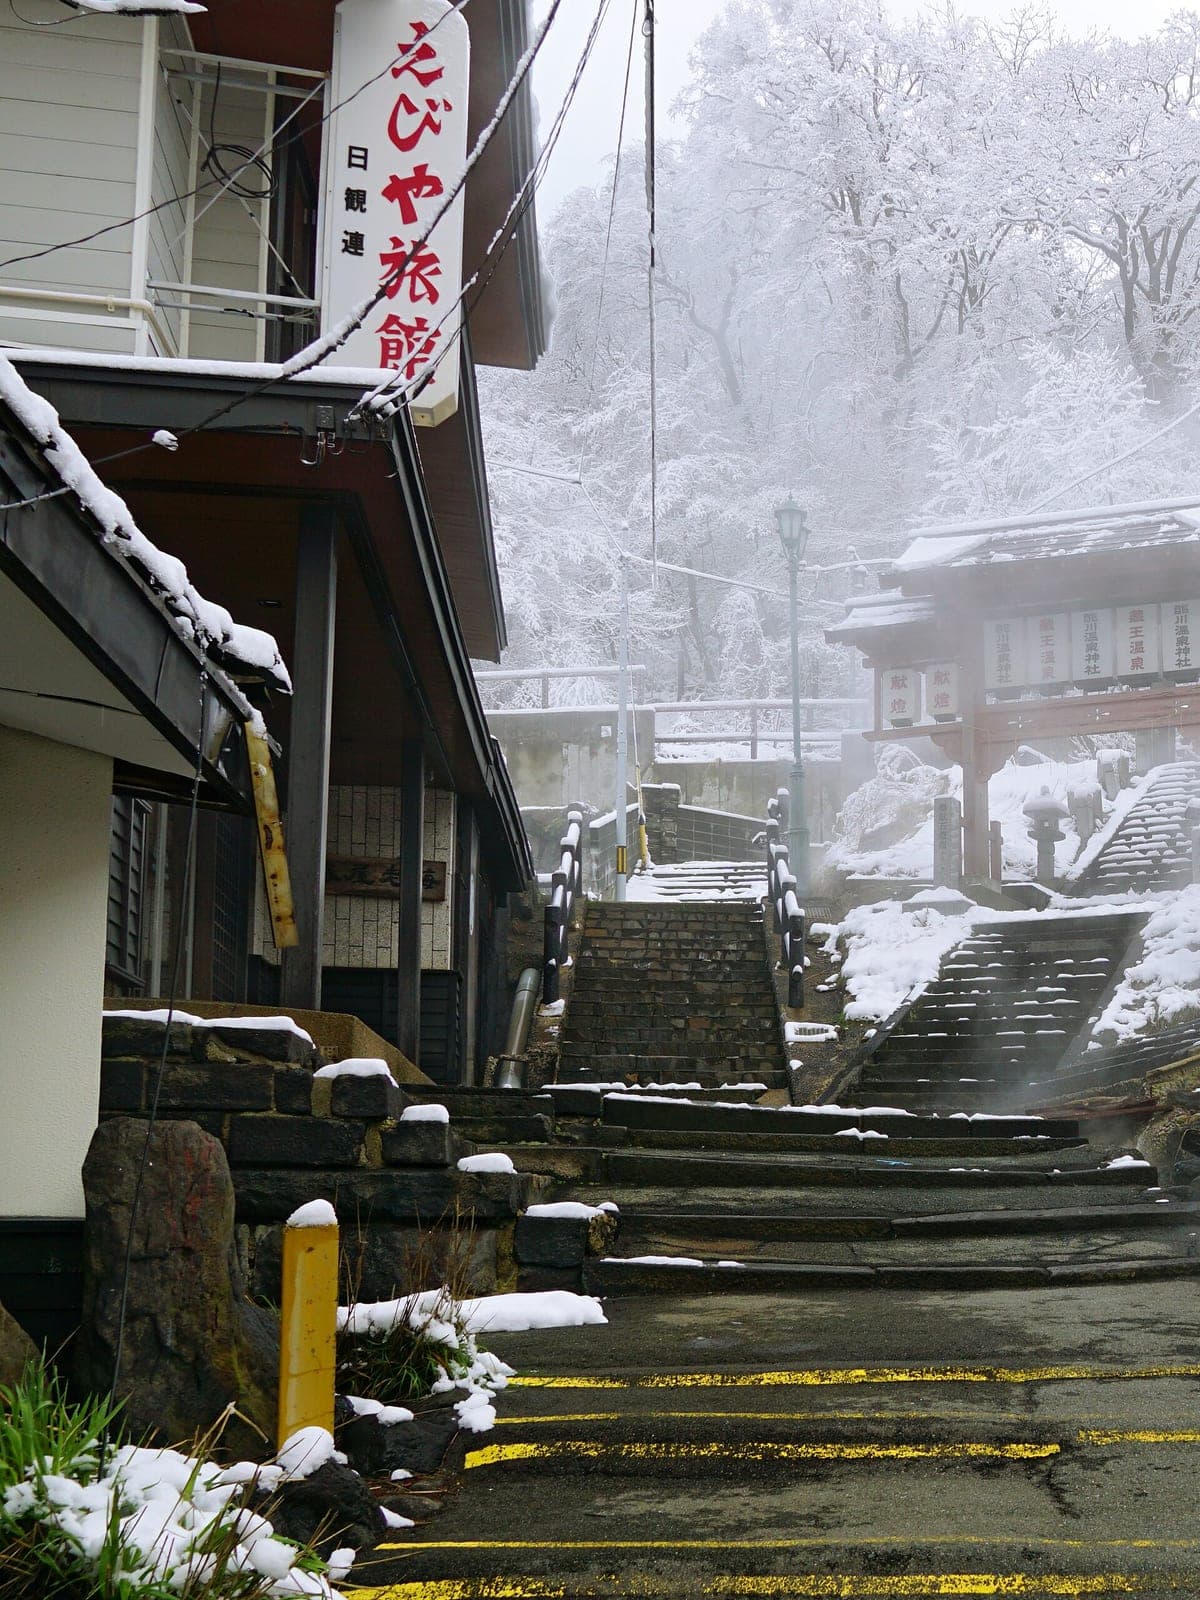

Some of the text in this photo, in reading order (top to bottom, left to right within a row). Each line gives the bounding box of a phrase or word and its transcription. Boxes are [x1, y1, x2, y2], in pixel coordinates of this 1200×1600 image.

[342, 146, 369, 257] 日観連
[375, 21, 453, 385] えびや旅館
